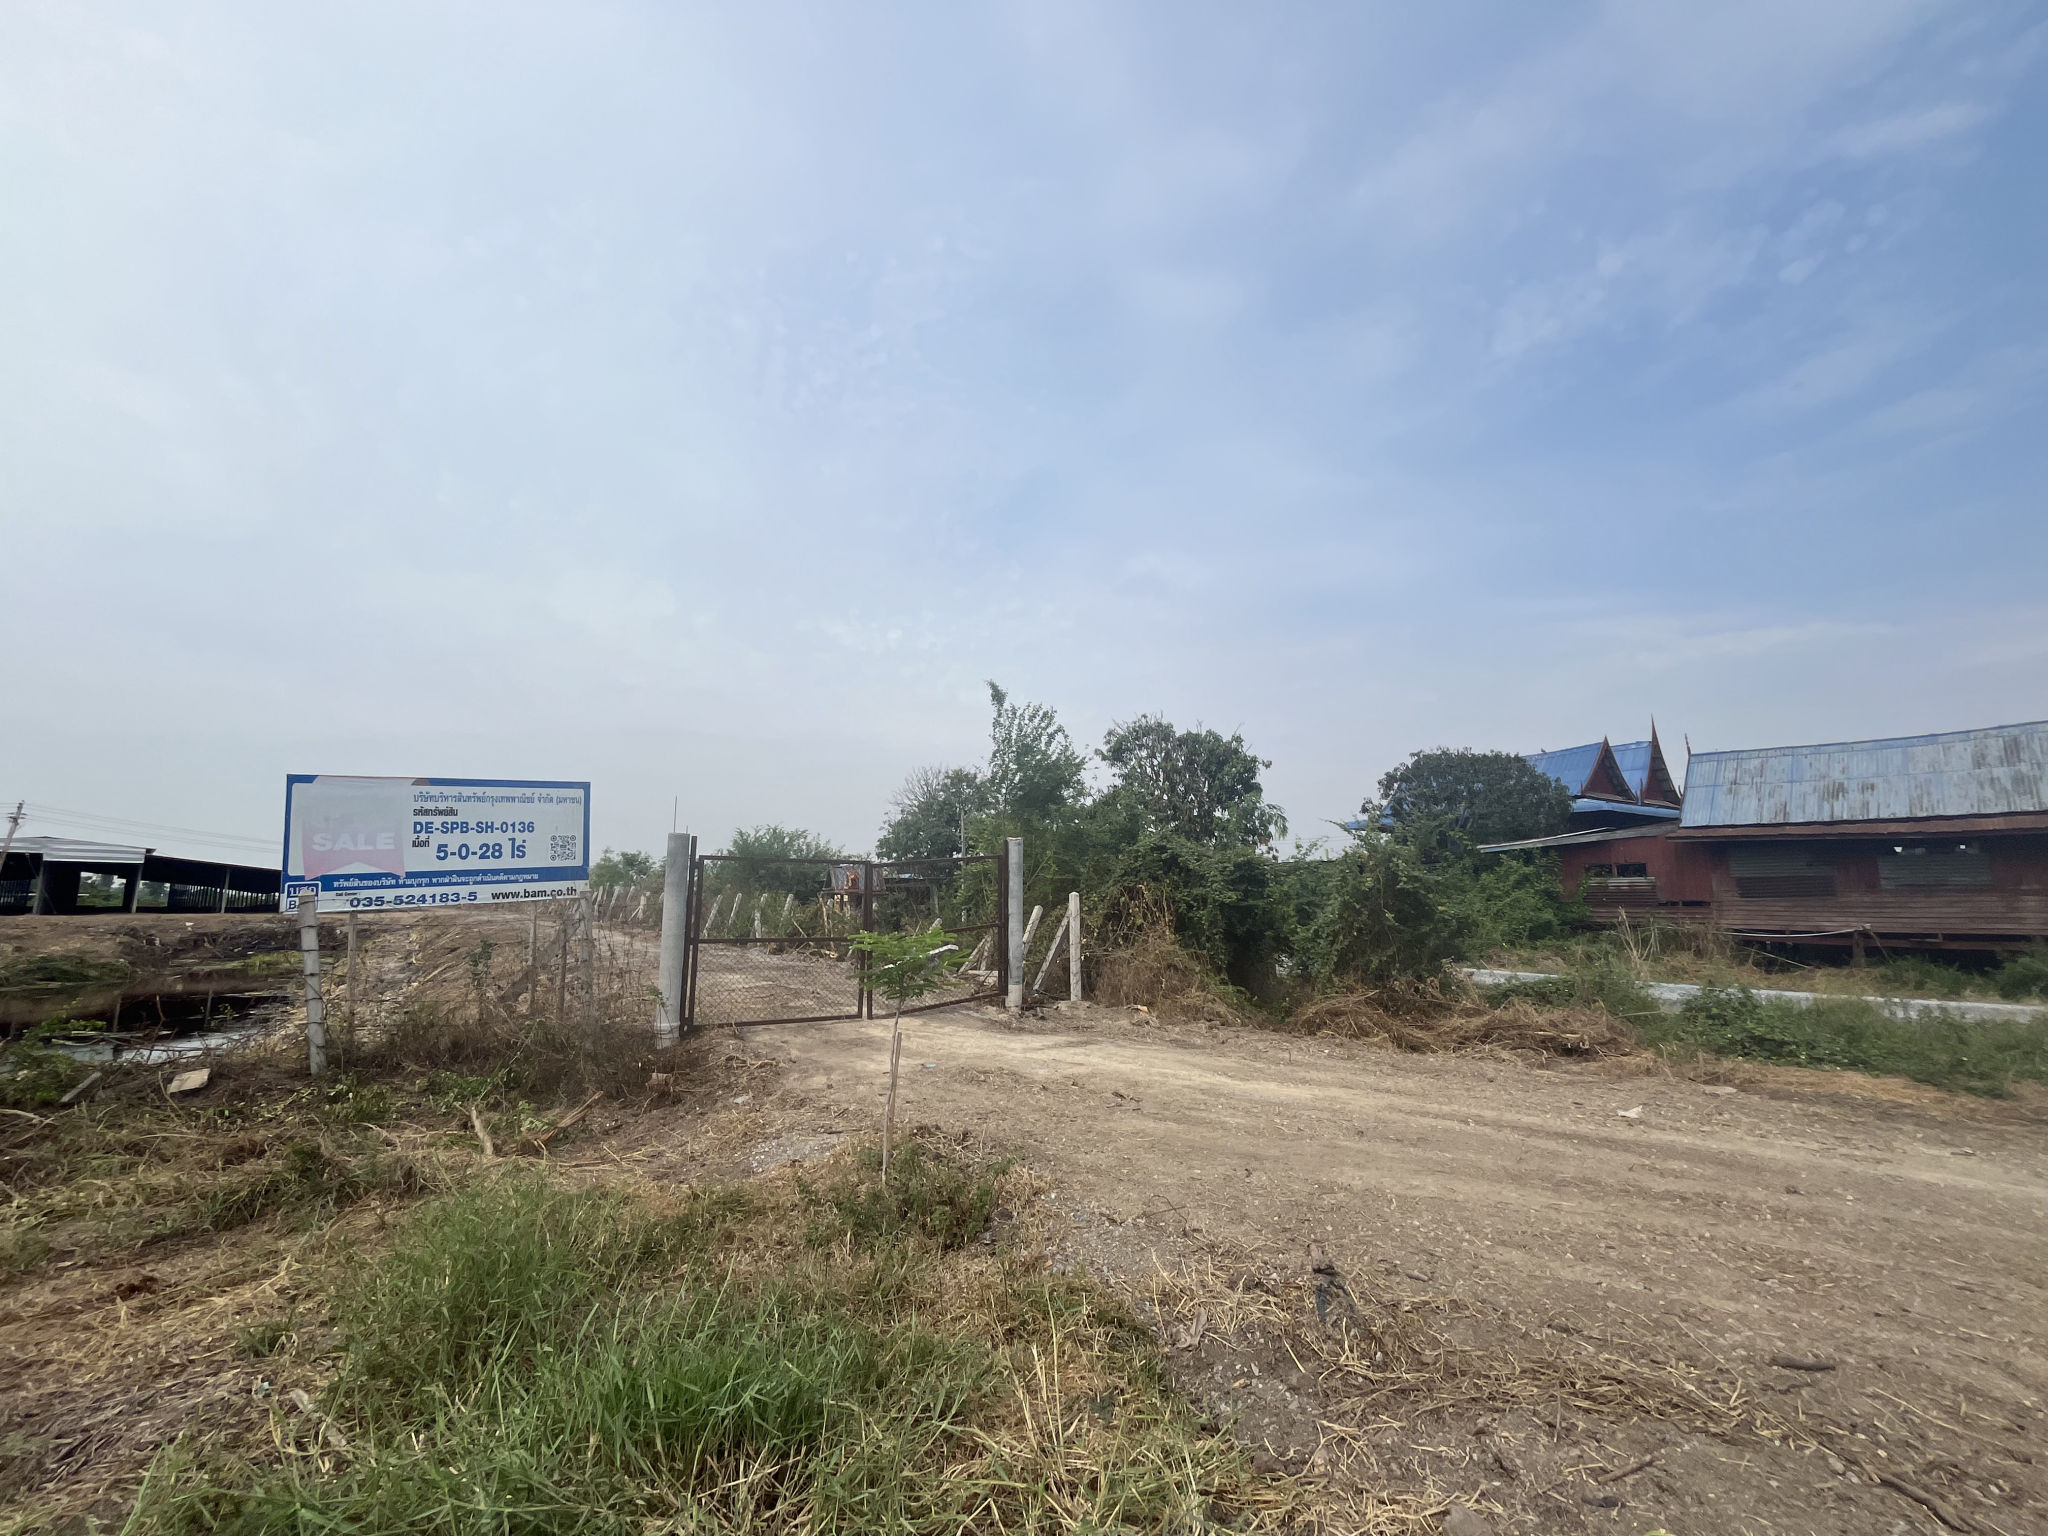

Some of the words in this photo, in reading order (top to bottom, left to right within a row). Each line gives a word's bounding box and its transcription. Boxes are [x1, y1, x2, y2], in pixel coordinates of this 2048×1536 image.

[538, 793, 553, 804] จำกัด
[556, 795, 582, 805] (มหาชน)
[412, 806, 458, 817] รหัสทรัพย์สิน
[413, 821, 535, 834] DE-SPB-SH-0136
[311, 832, 396, 851] SALE
[412, 835, 430, 848] เนื้อที่
[436, 843, 503, 861] 5-0-28
[508, 837, 527, 859] ไร่
[349, 891, 478, 908] 035-524183-5
[491, 886, 577, 900] www.bam.co.th
